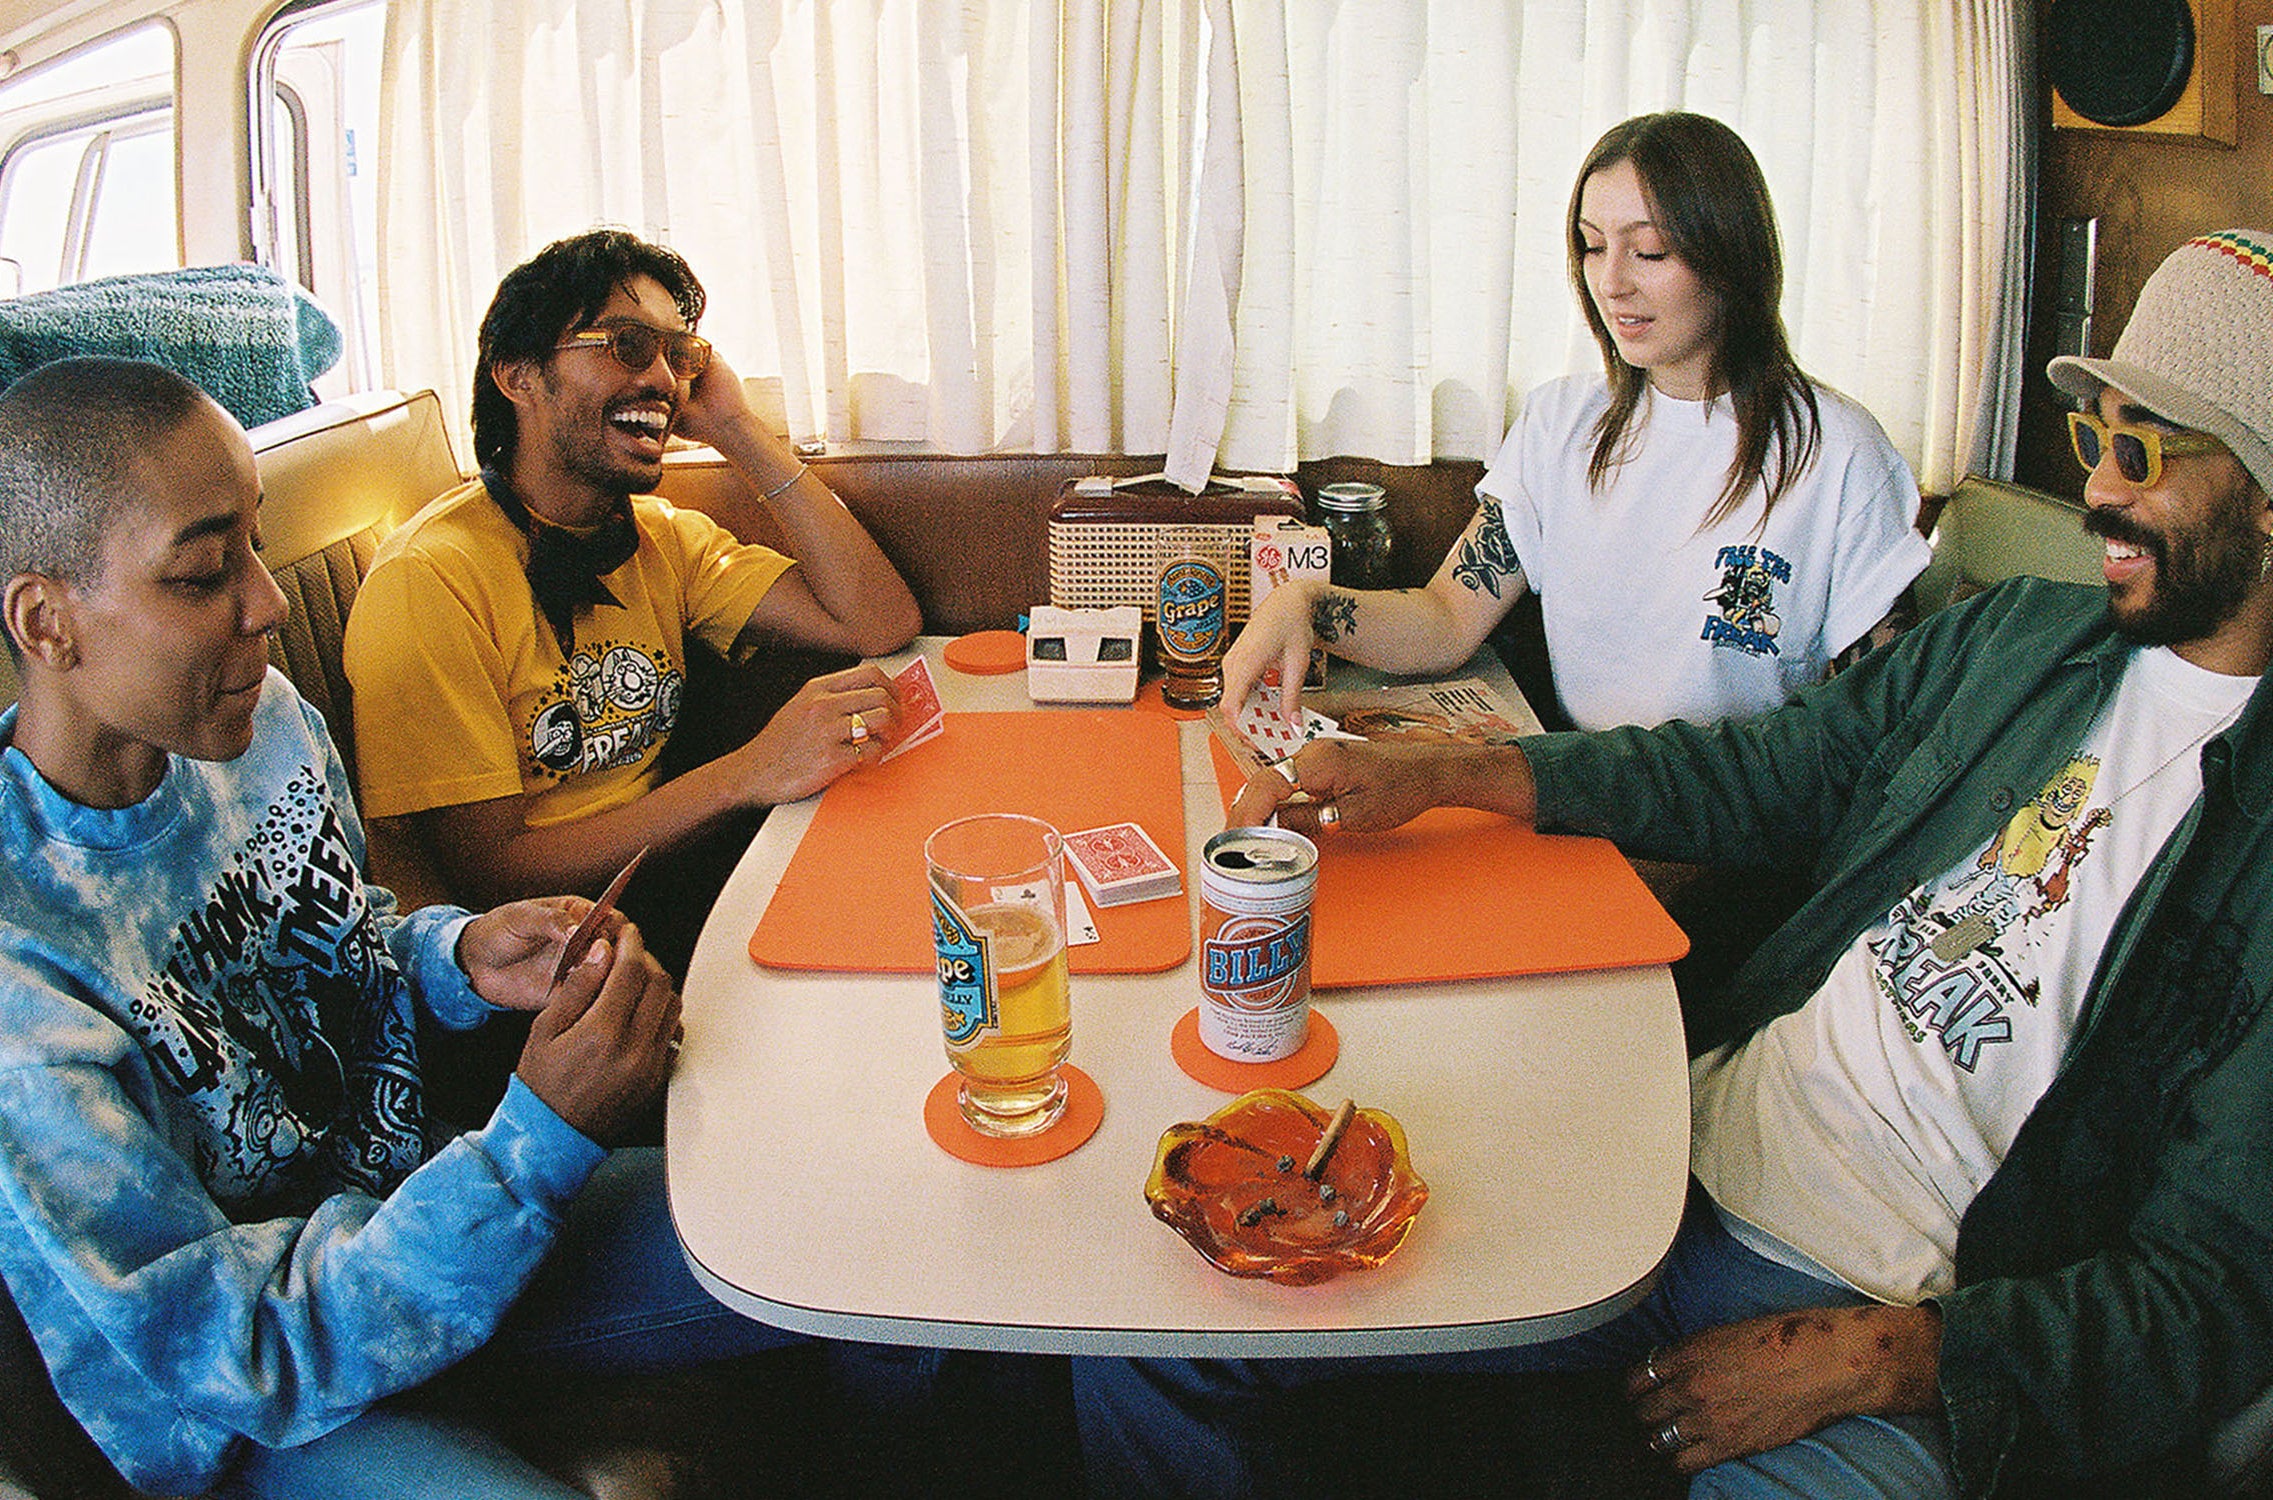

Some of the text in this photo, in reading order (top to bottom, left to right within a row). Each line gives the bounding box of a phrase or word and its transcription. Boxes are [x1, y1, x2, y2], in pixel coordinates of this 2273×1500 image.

[1287, 546, 1328, 569] M3
[1164, 595, 1220, 624] Grape
[1208, 922, 1307, 985] BILLY
